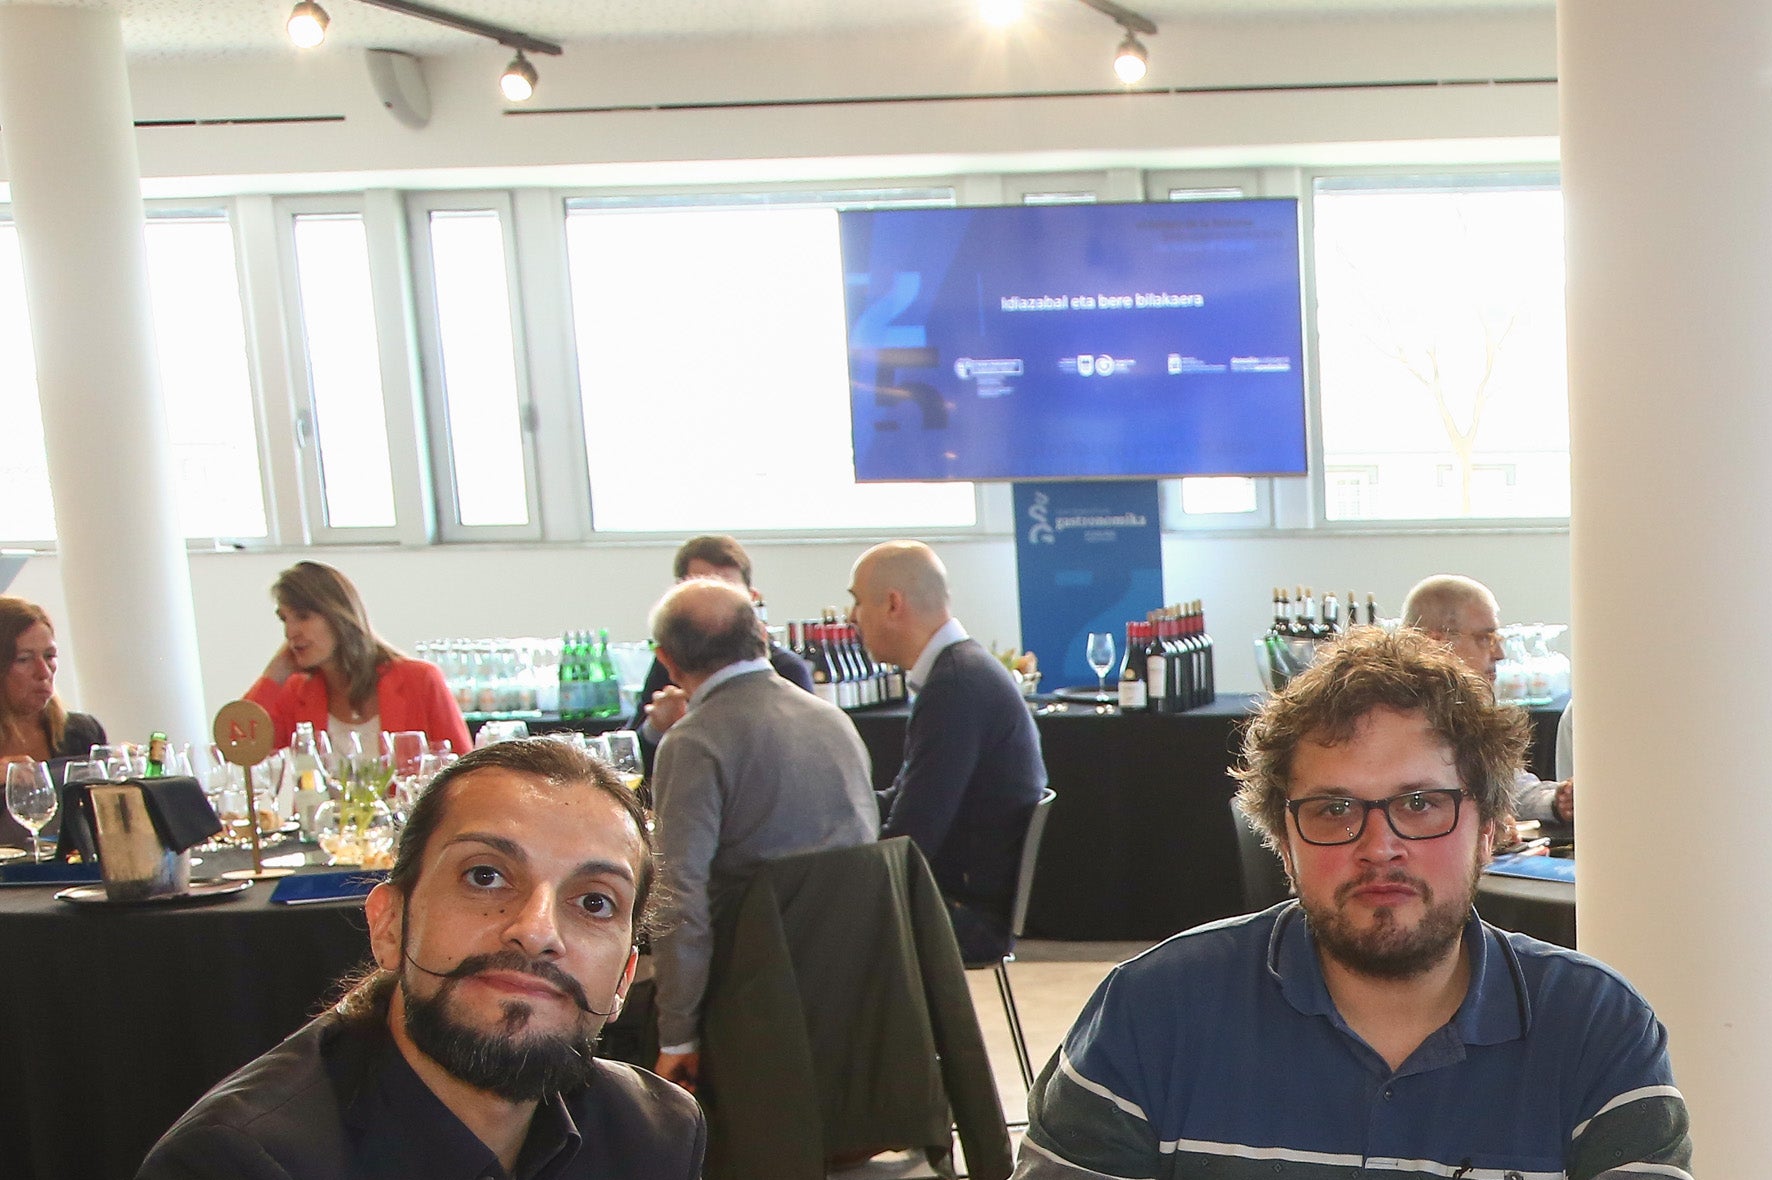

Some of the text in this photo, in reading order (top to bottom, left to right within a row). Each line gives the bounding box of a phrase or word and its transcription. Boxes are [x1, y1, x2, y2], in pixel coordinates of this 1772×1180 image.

[1071, 296, 1095, 309] eta
[1098, 294, 1132, 309] bere
[1135, 293, 1204, 308] bilakaera
